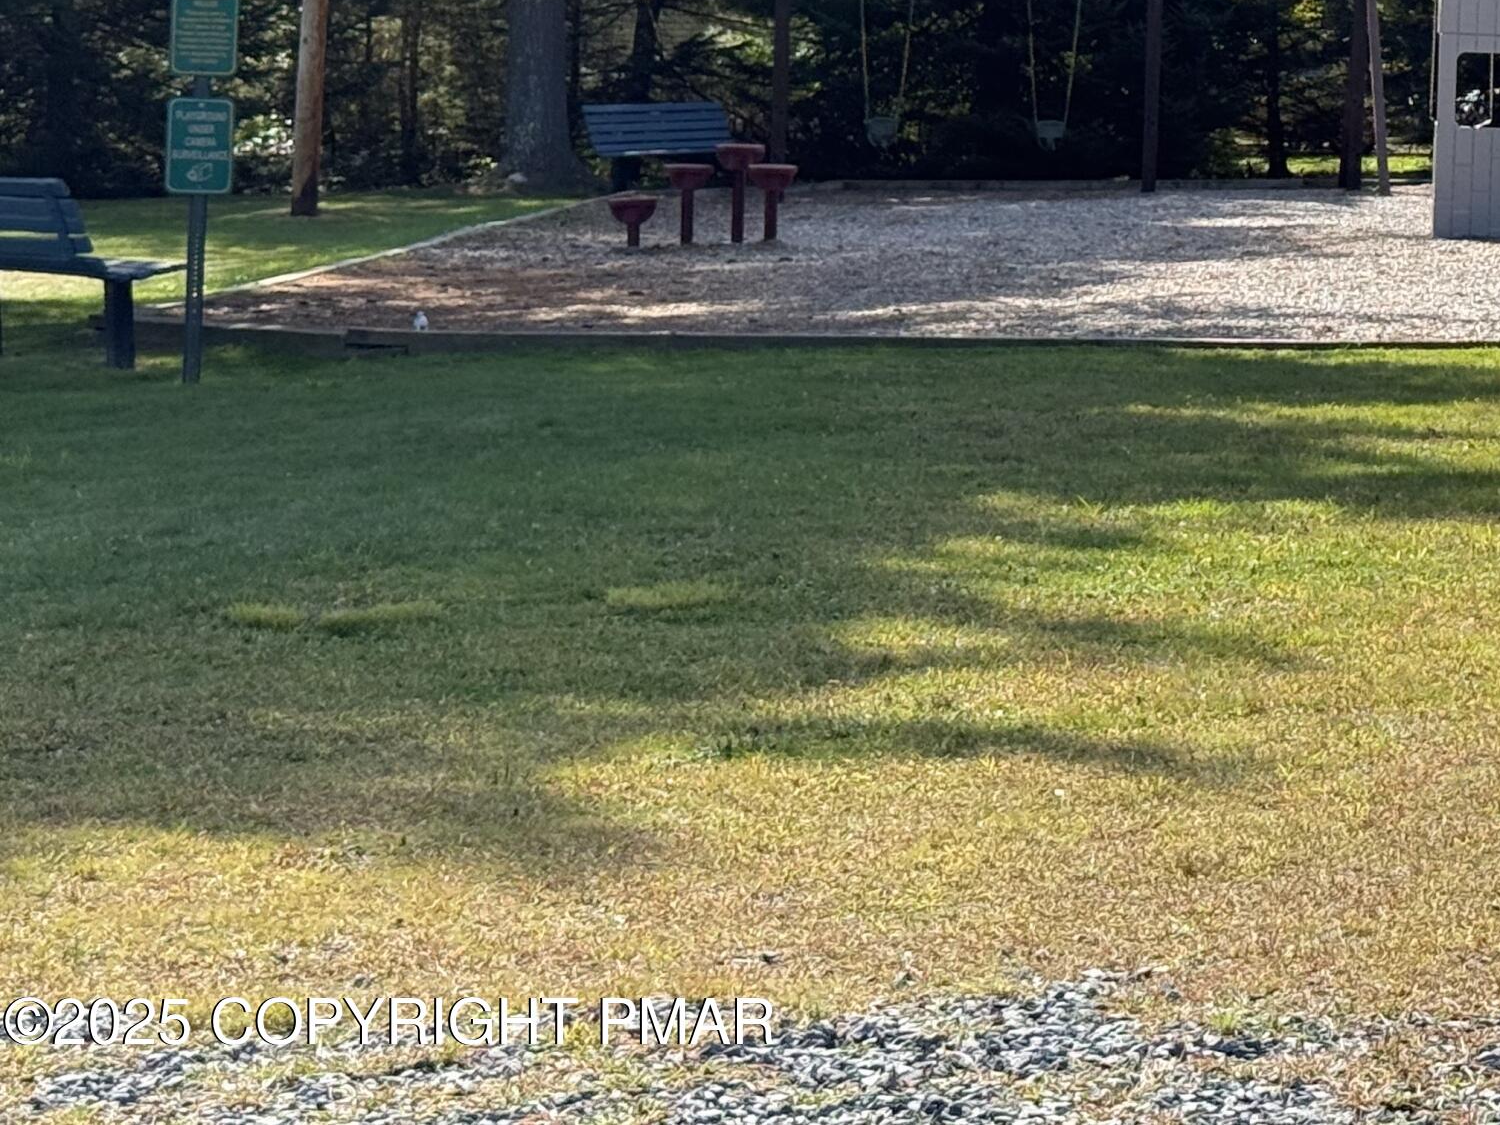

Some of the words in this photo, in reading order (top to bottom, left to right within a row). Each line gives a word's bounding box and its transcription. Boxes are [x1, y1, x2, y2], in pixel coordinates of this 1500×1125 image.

[175, 110, 228, 121] PLAYGROUND
[188, 124, 215, 134] UNDER
[184, 137, 217, 147] CAMERA
[172, 149, 230, 160] SURVEILLANCE
